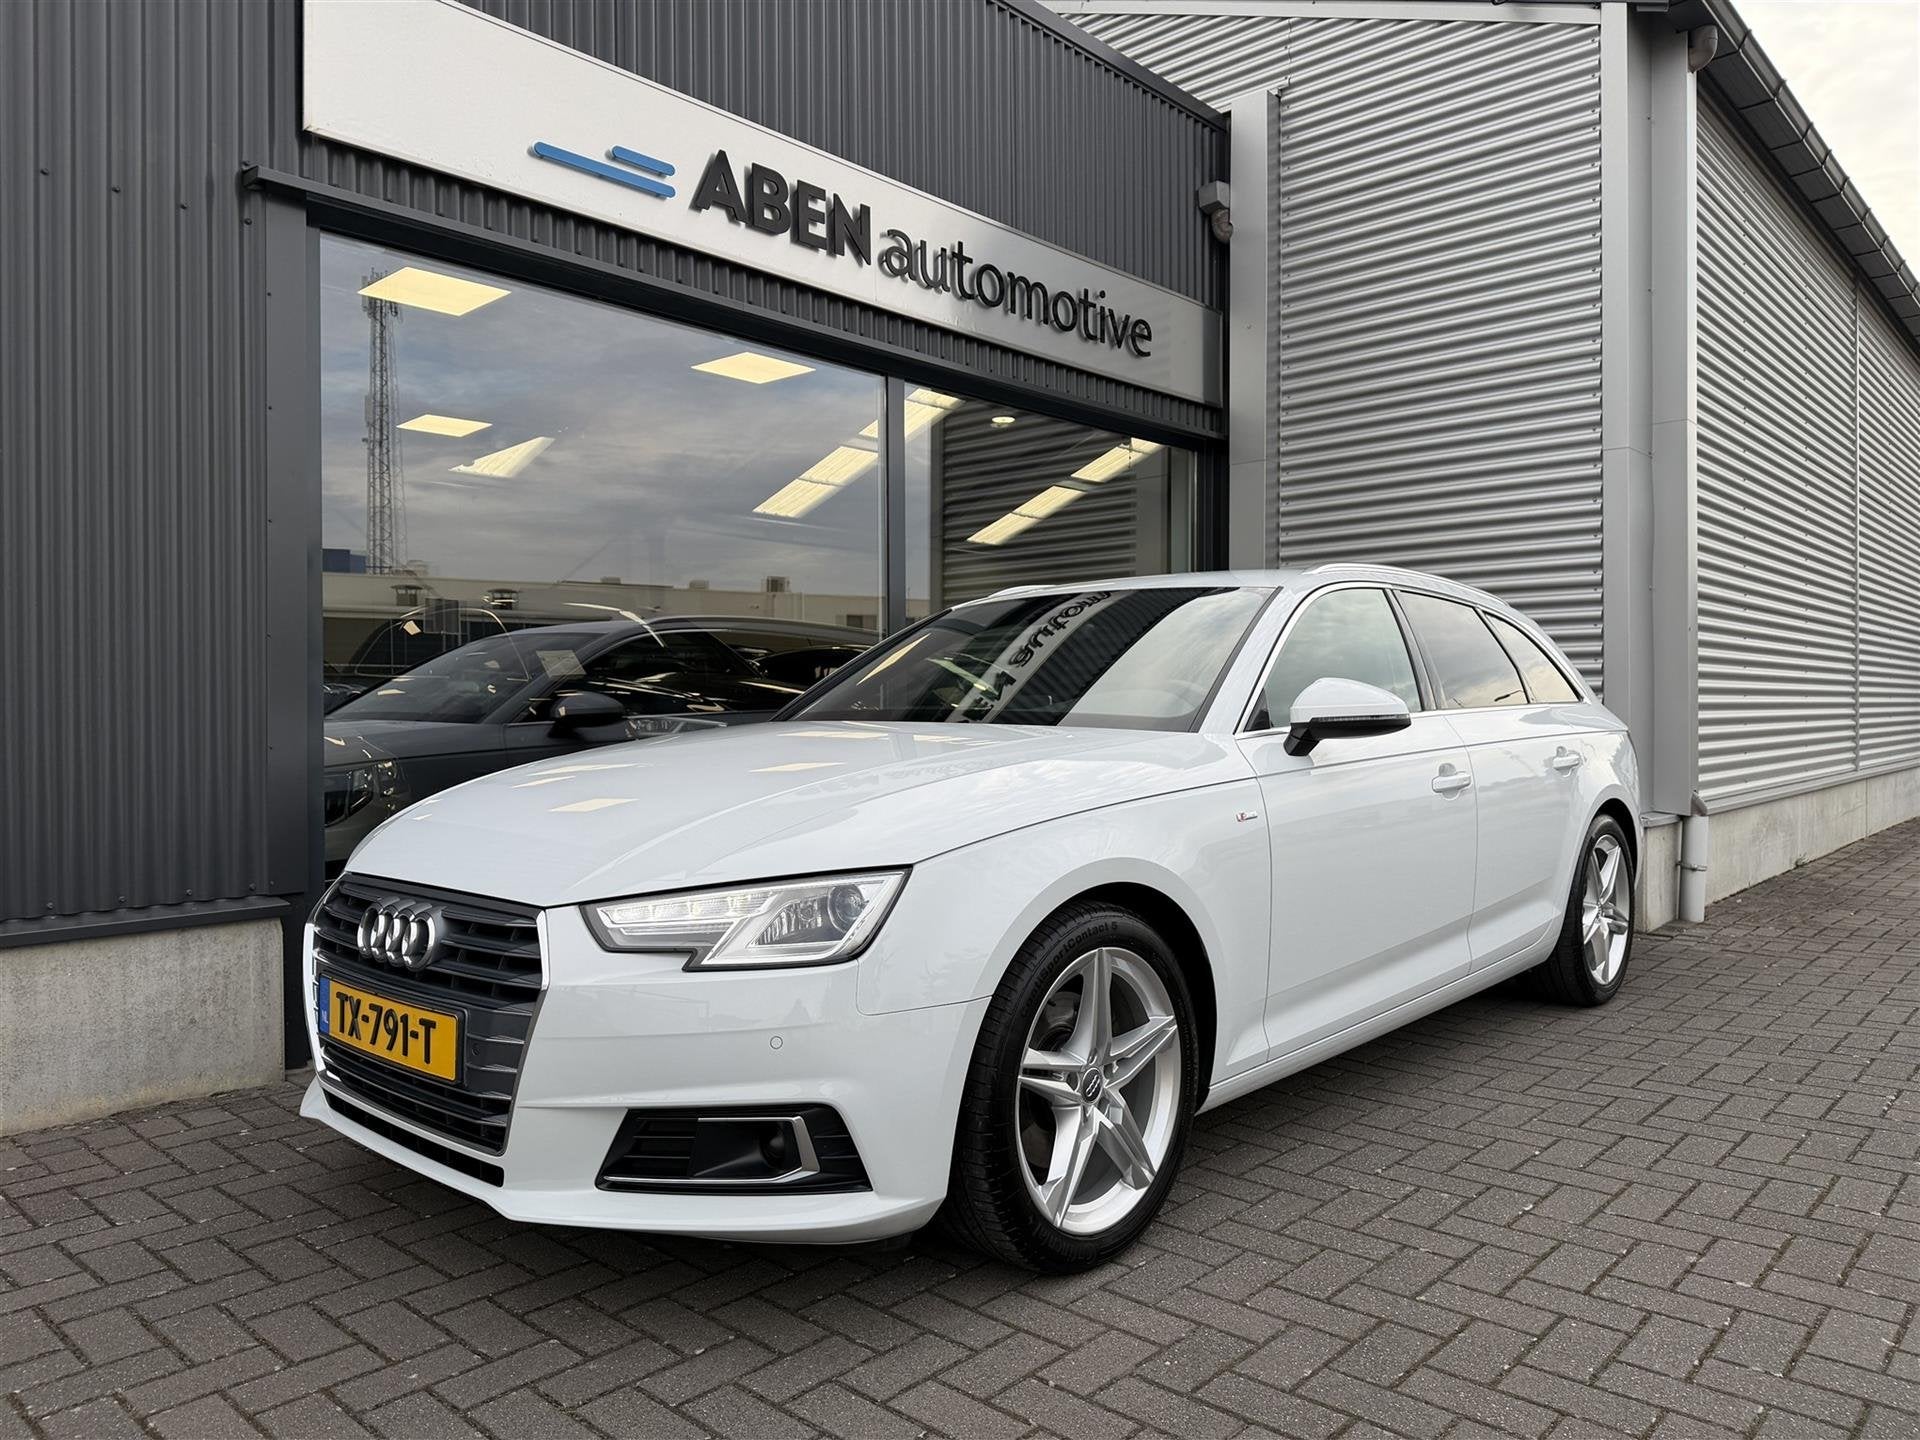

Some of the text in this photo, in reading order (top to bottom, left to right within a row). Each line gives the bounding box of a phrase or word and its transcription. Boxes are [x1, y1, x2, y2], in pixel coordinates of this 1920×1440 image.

[694, 150, 1153, 358] ABEN automotive
[336, 991, 436, 1065] TX-791-T
